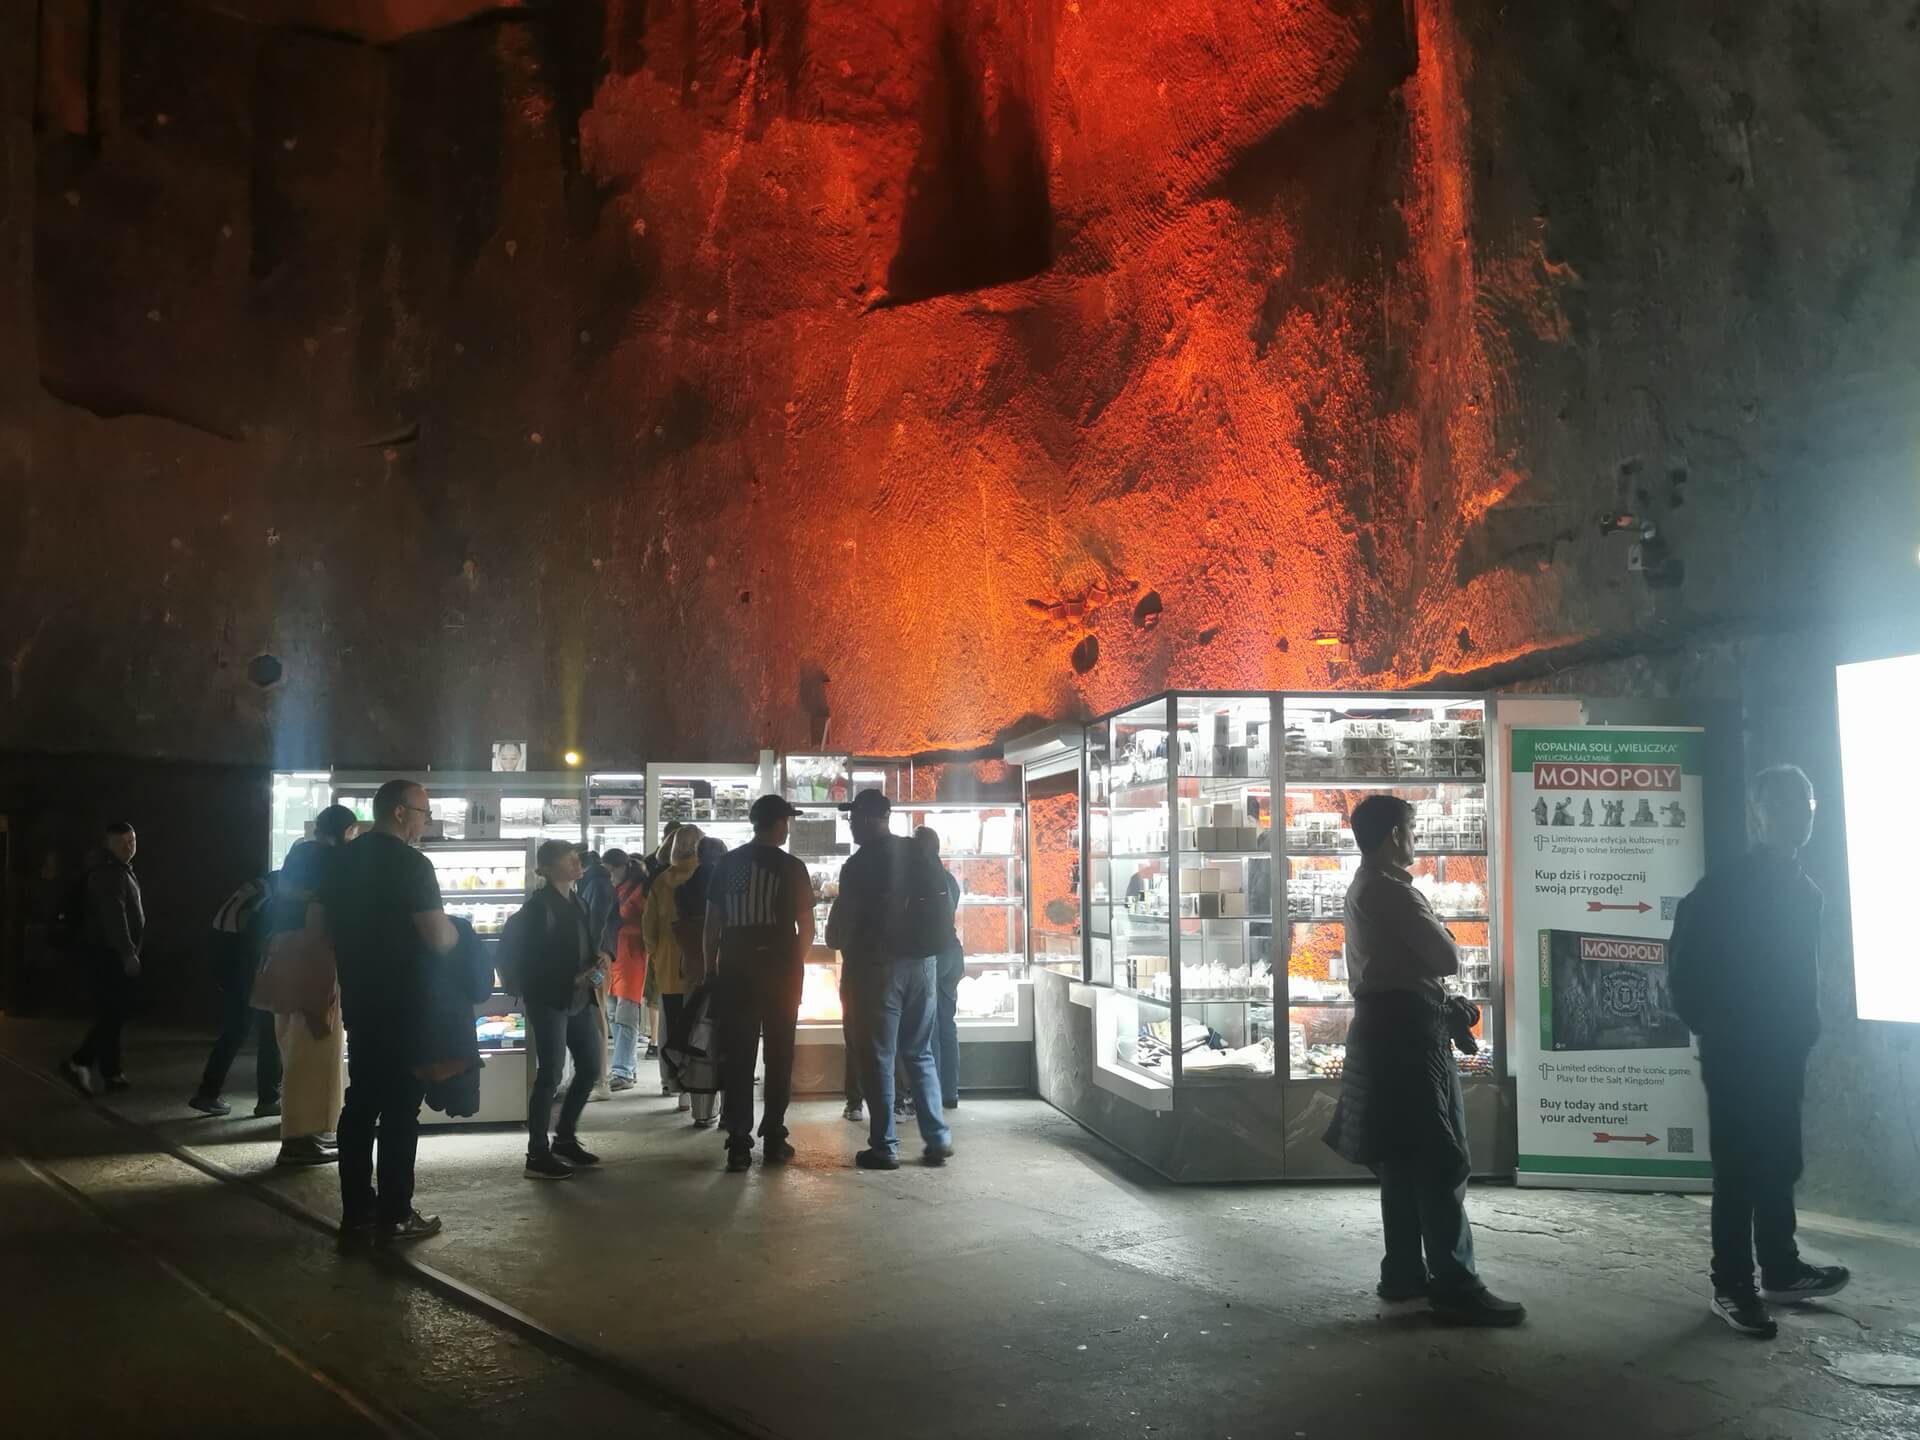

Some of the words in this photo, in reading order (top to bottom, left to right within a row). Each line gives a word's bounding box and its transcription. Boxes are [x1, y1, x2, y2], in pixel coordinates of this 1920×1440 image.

[1535, 742, 1587, 752] KOPALNIA
[1590, 743, 1612, 752] SOLI
[1538, 767, 1677, 788] MONOPOLY
[1551, 834, 1598, 844] Limitowana
[1600, 834, 1626, 845] edycja
[1551, 845, 1577, 855] Zagraj
[1586, 846, 1608, 854] solne
[1610, 846, 1654, 854] królestwo!
[1535, 870, 1557, 882] Kup
[1559, 869, 1580, 880] dziś
[1583, 870, 1586, 880] i
[1589, 871, 1646, 883] rozpocznij
[1535, 884, 1566, 896] swoją
[1569, 884, 1624, 896] przygodę!
[1584, 942, 1662, 960] MONOPOLY
[1556, 1064, 1586, 1072] Limited
[1587, 1064, 1616, 1074] edition
[1617, 1064, 1626, 1074] of
[1627, 1064, 1642, 1074] the
[1643, 1065, 1667, 1074] iconic
[1556, 1075, 1574, 1085] Play
[1576, 1075, 1588, 1084] for
[1590, 1076, 1604, 1084] the
[1606, 1076, 1622, 1084] Salt
[1624, 1076, 1665, 1086] Kingdom!
[1540, 1098, 1561, 1110] Buy
[1564, 1099, 1596, 1112] today
[1598, 1100, 1619, 1110] and
[1622, 1101, 1648, 1112] start
[1540, 1114, 1566, 1125] your
[1568, 1112, 1628, 1125] adventure!
